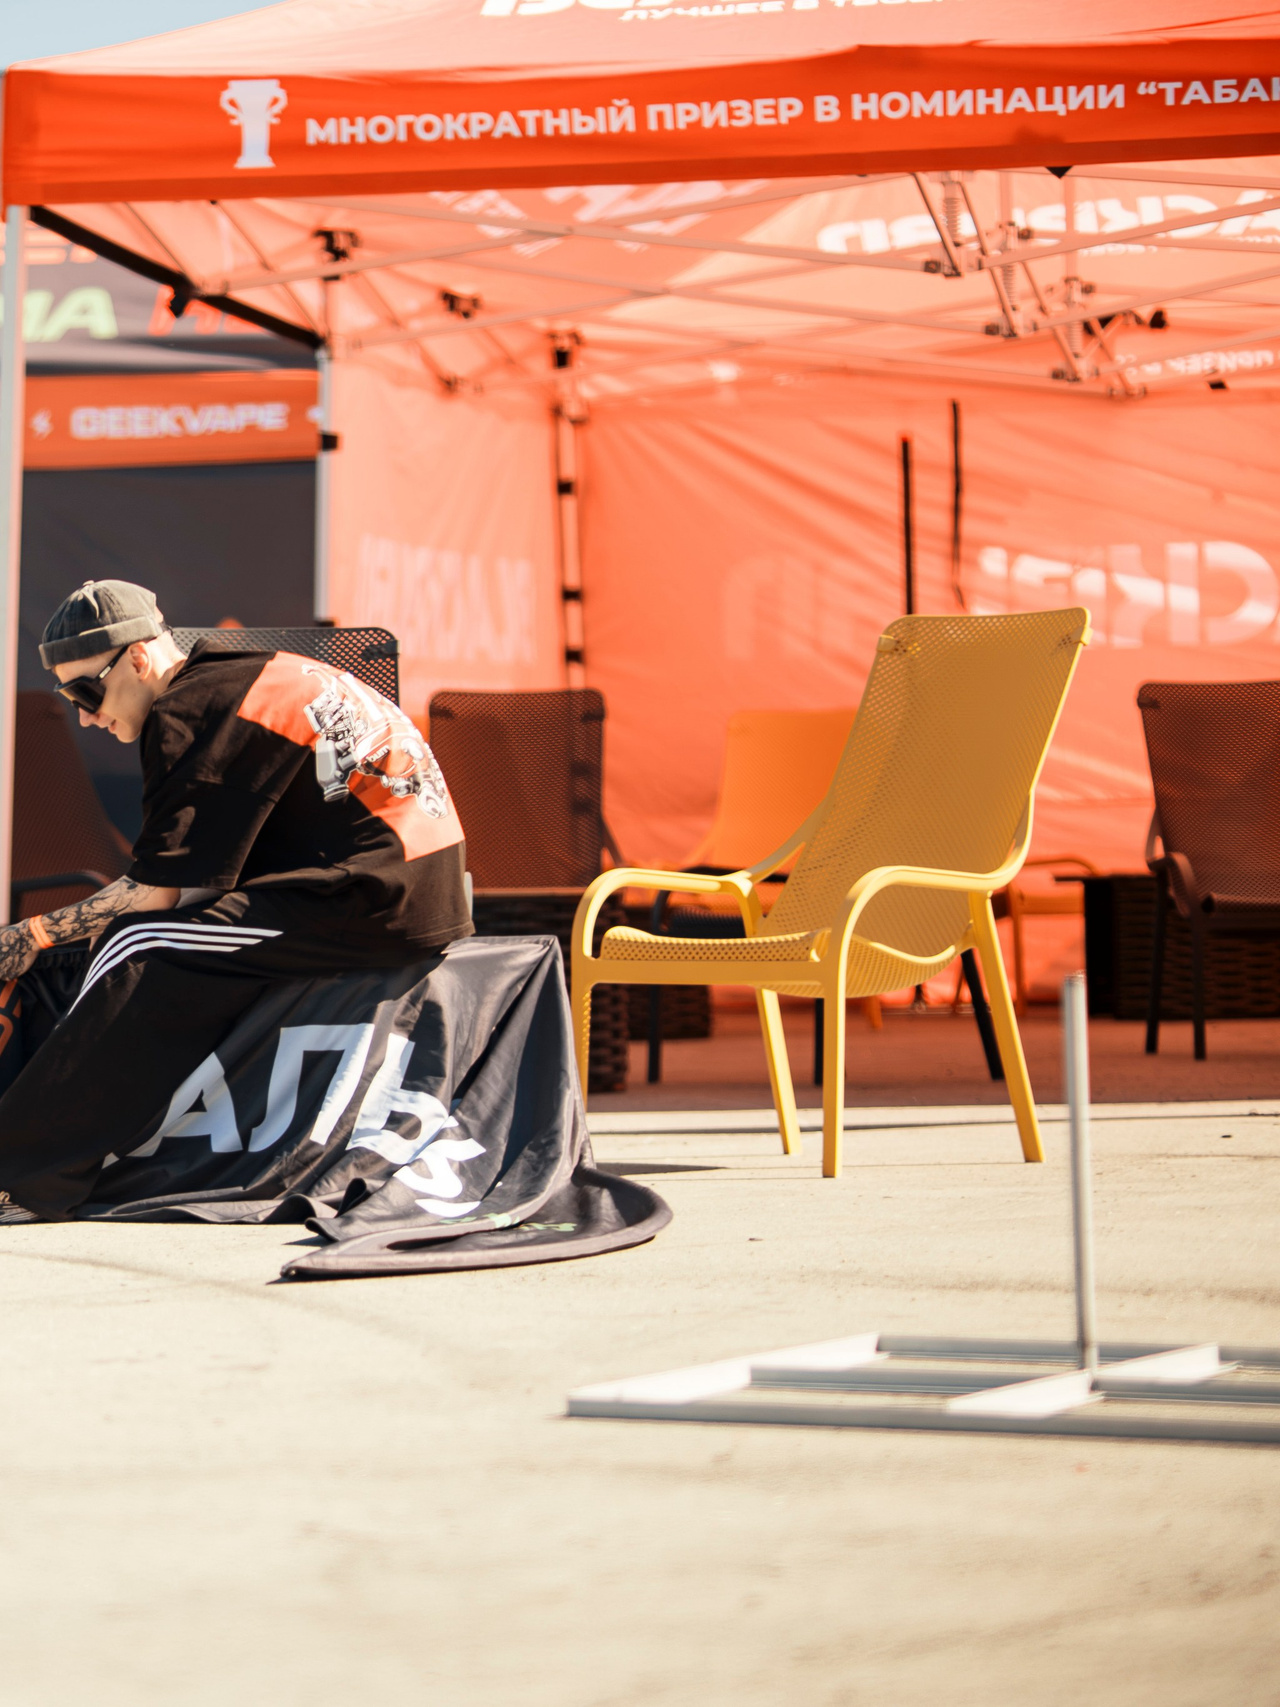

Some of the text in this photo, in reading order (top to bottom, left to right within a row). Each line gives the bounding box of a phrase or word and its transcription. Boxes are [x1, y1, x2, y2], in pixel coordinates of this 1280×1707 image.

[305, 98, 637, 146] МНОГОКРАТНЫЙ
[646, 97, 804, 131] ПРИЗЕР
[814, 95, 841, 123] В
[851, 83, 1126, 121] НОМИНАЦИИ
[70, 403, 289, 440] GEEKVAPE
